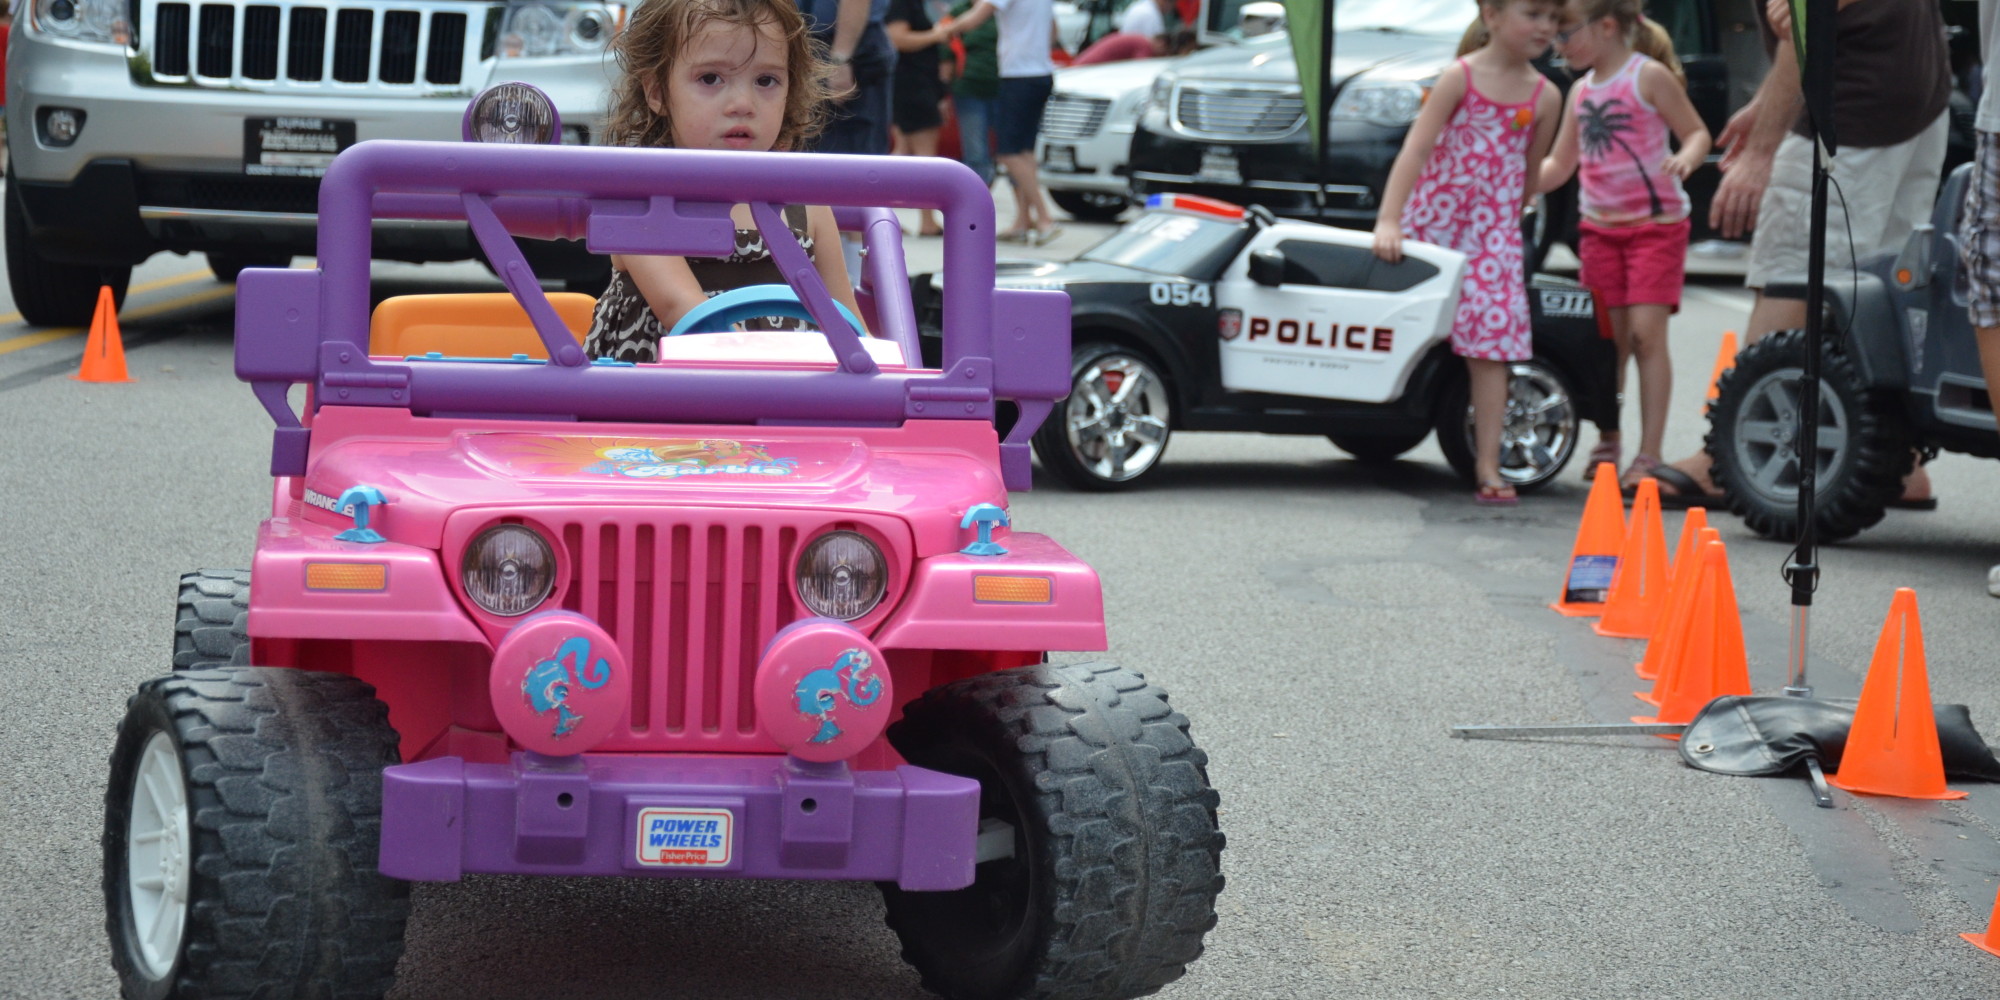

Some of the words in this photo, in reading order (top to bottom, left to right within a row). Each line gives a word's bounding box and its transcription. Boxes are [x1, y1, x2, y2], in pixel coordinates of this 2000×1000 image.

[1150, 283, 1212, 307] 054
[1541, 290, 1594, 315] 911
[1249, 317, 1393, 353] POLICE
[623, 464, 791, 479] Barbie
[651, 819, 718, 833] POWER
[649, 833, 722, 848] WHEELS
